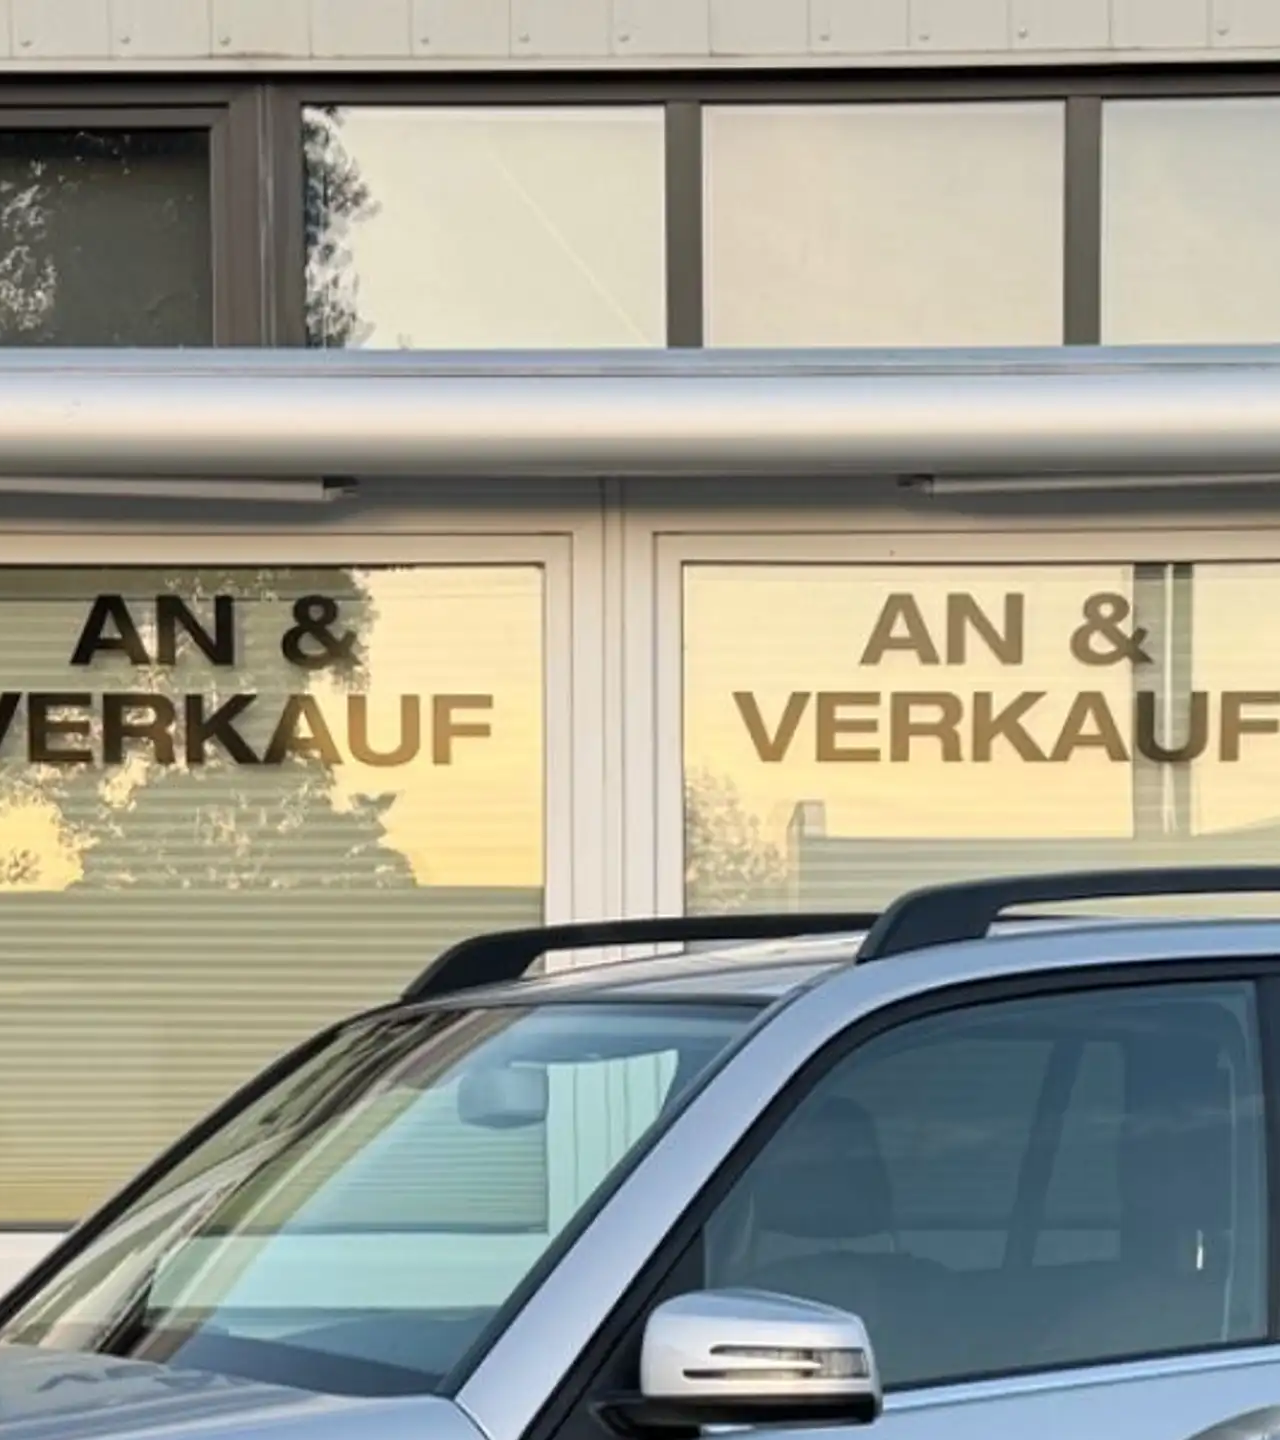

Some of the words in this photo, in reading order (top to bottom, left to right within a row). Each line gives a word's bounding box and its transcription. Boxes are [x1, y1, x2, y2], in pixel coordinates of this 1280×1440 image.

[69, 594, 235, 666] AN
[281, 594, 361, 667] &
[860, 593, 1024, 666] AN
[1070, 592, 1153, 666] &
